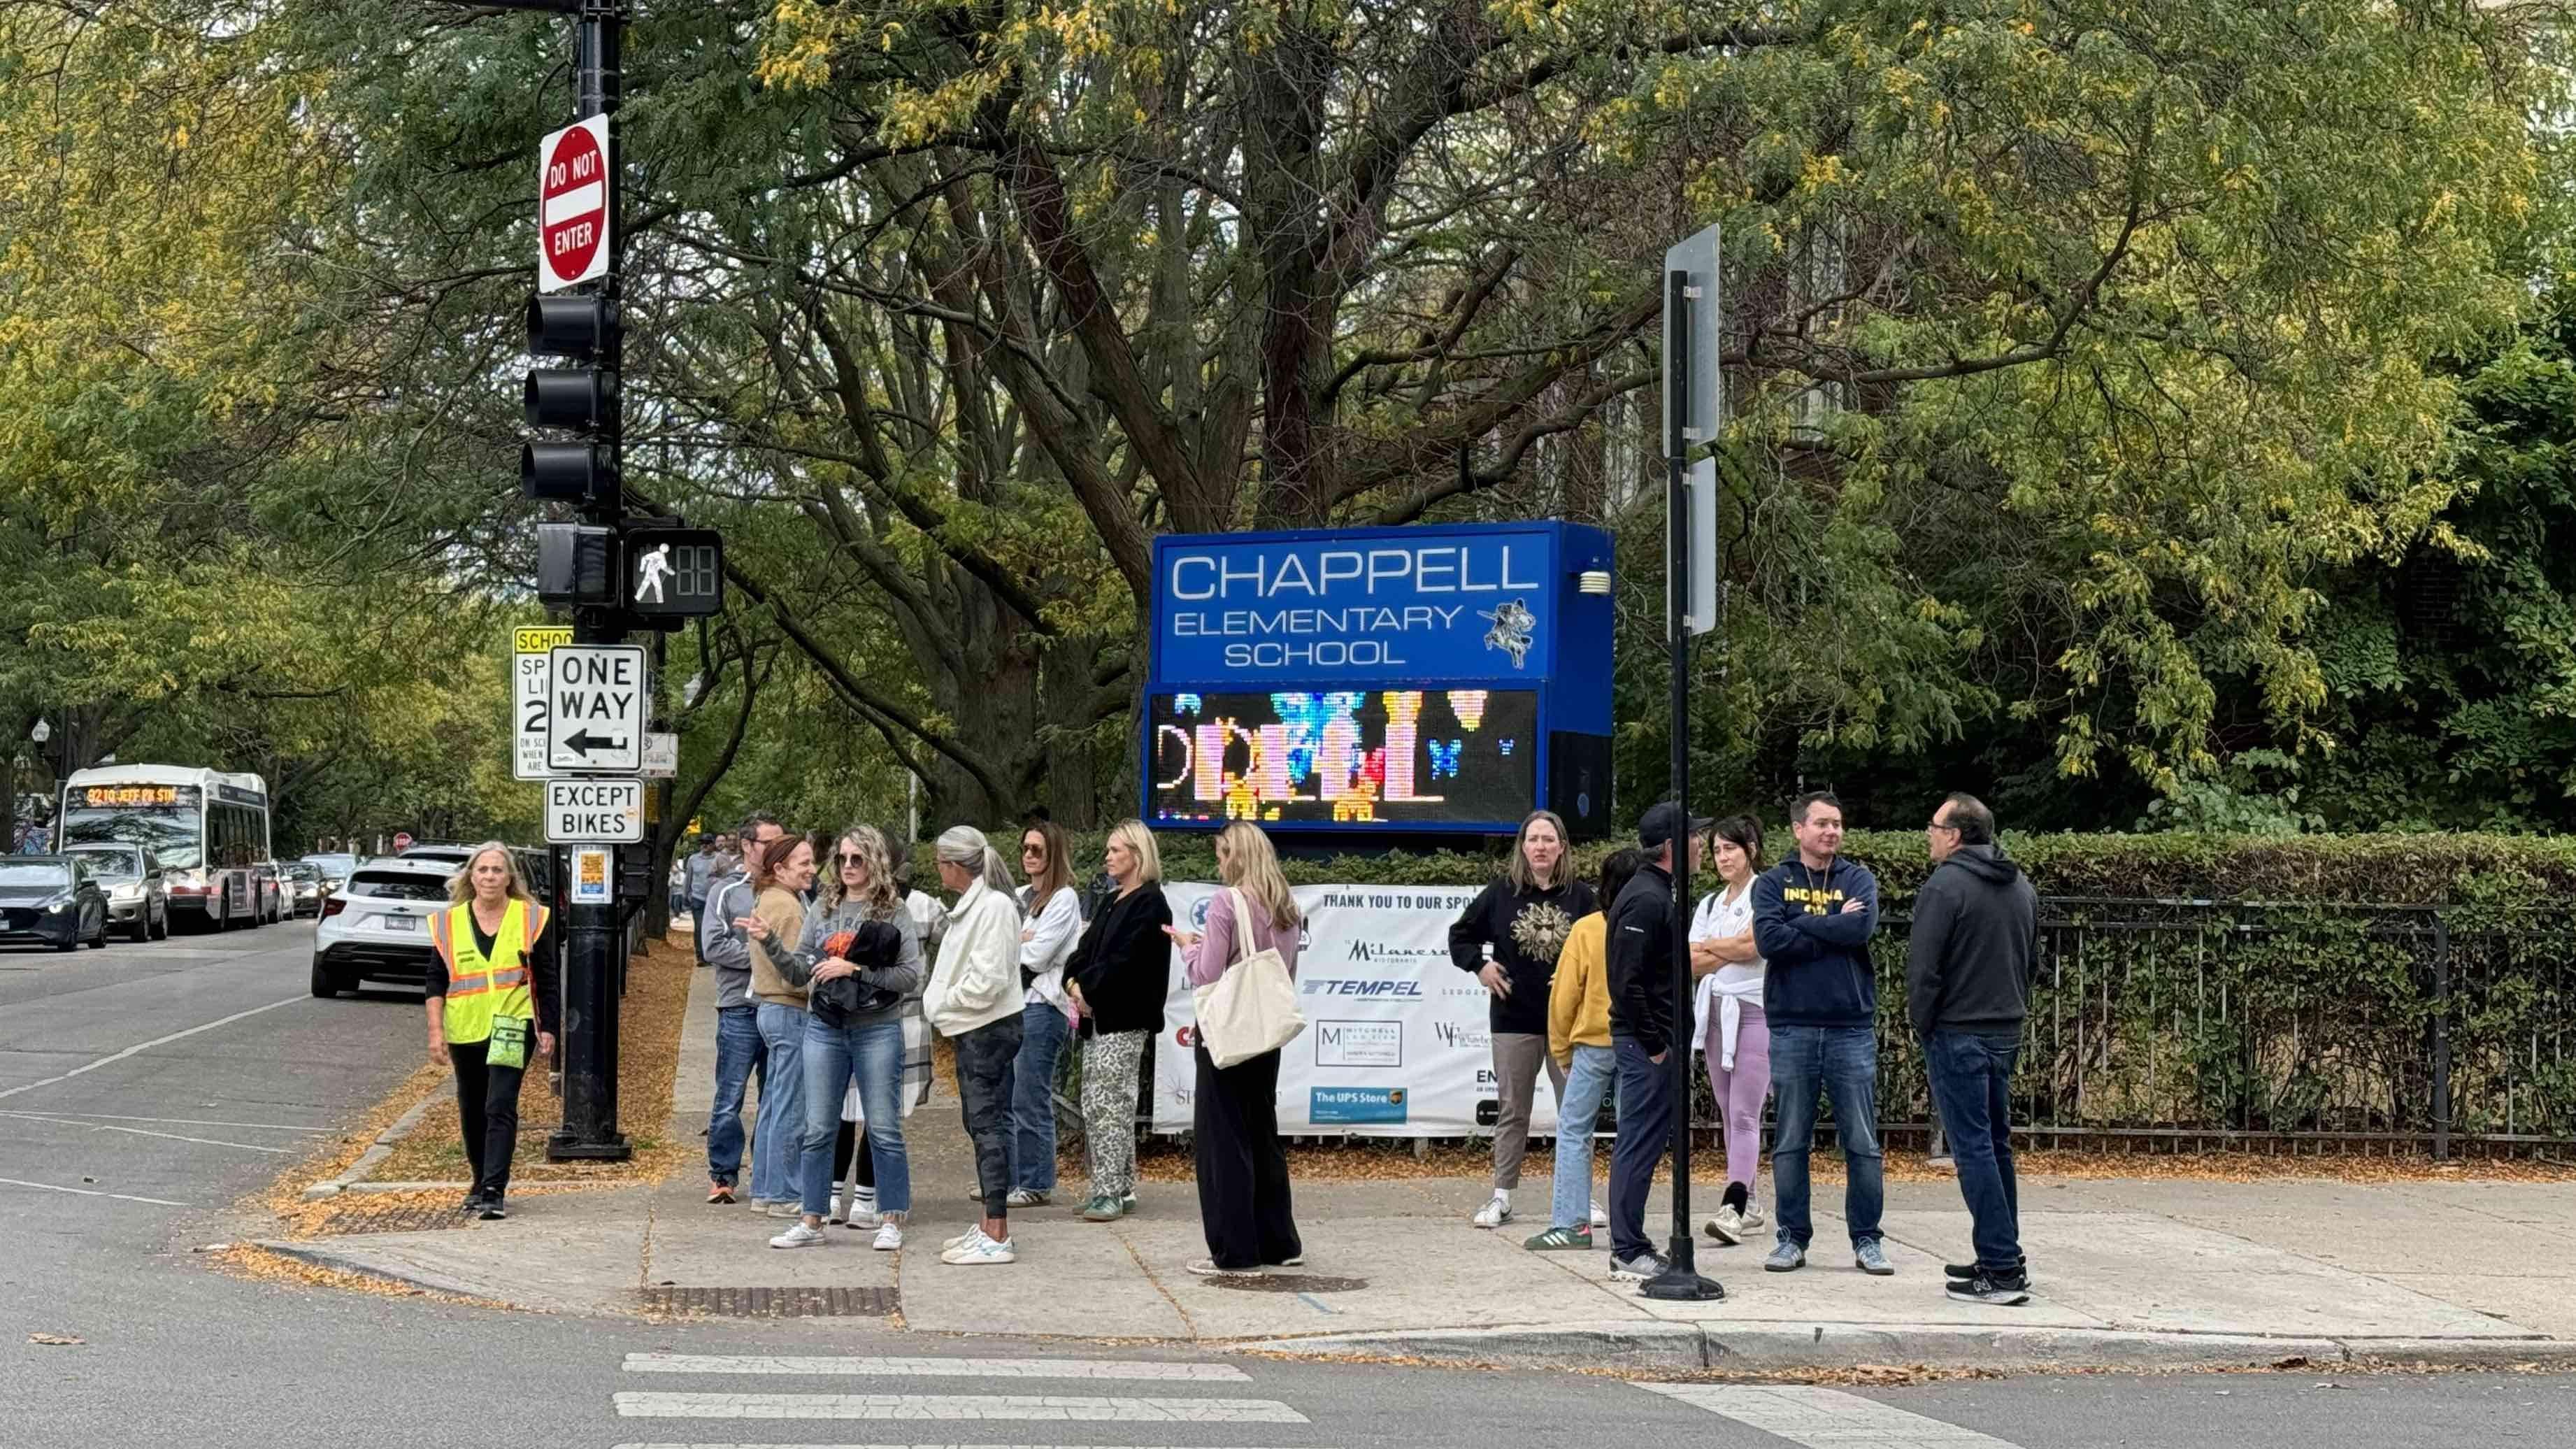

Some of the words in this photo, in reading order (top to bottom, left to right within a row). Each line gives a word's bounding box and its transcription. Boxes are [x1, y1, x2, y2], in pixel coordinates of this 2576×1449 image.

[550, 163, 566, 189] DO
[573, 150, 596, 180] NOT
[554, 222, 592, 256] ENTER
[1172, 545, 1538, 600] CHAPPELL
[1174, 605, 1464, 636] ELEMENTARY
[1224, 641, 1405, 666] SCHOOL
[562, 657, 631, 685] ONE
[560, 691, 634, 720] WAY
[522, 750, 543, 759] WHEN
[527, 762, 542, 771] ARE
[103, 789, 115, 801] TO
[117, 789, 140, 802] JEFF
[142, 789, 155, 802] PK
[157, 788, 176, 802] STN
[554, 786, 634, 806] EXCEPT
[562, 813, 625, 834] BIKES
[1324, 894, 1364, 908] THANK
[1368, 894, 1392, 908] YOU
[1398, 895, 1411, 908] TO
[1416, 896, 1442, 909] OUR
[1326, 980, 1422, 996] TEMPEL
[1322, 1027, 1340, 1045] M
[1316, 1092, 1335, 1103] The
[1336, 1092, 1357, 1103] UPS
[1359, 1092, 1388, 1103] Store
